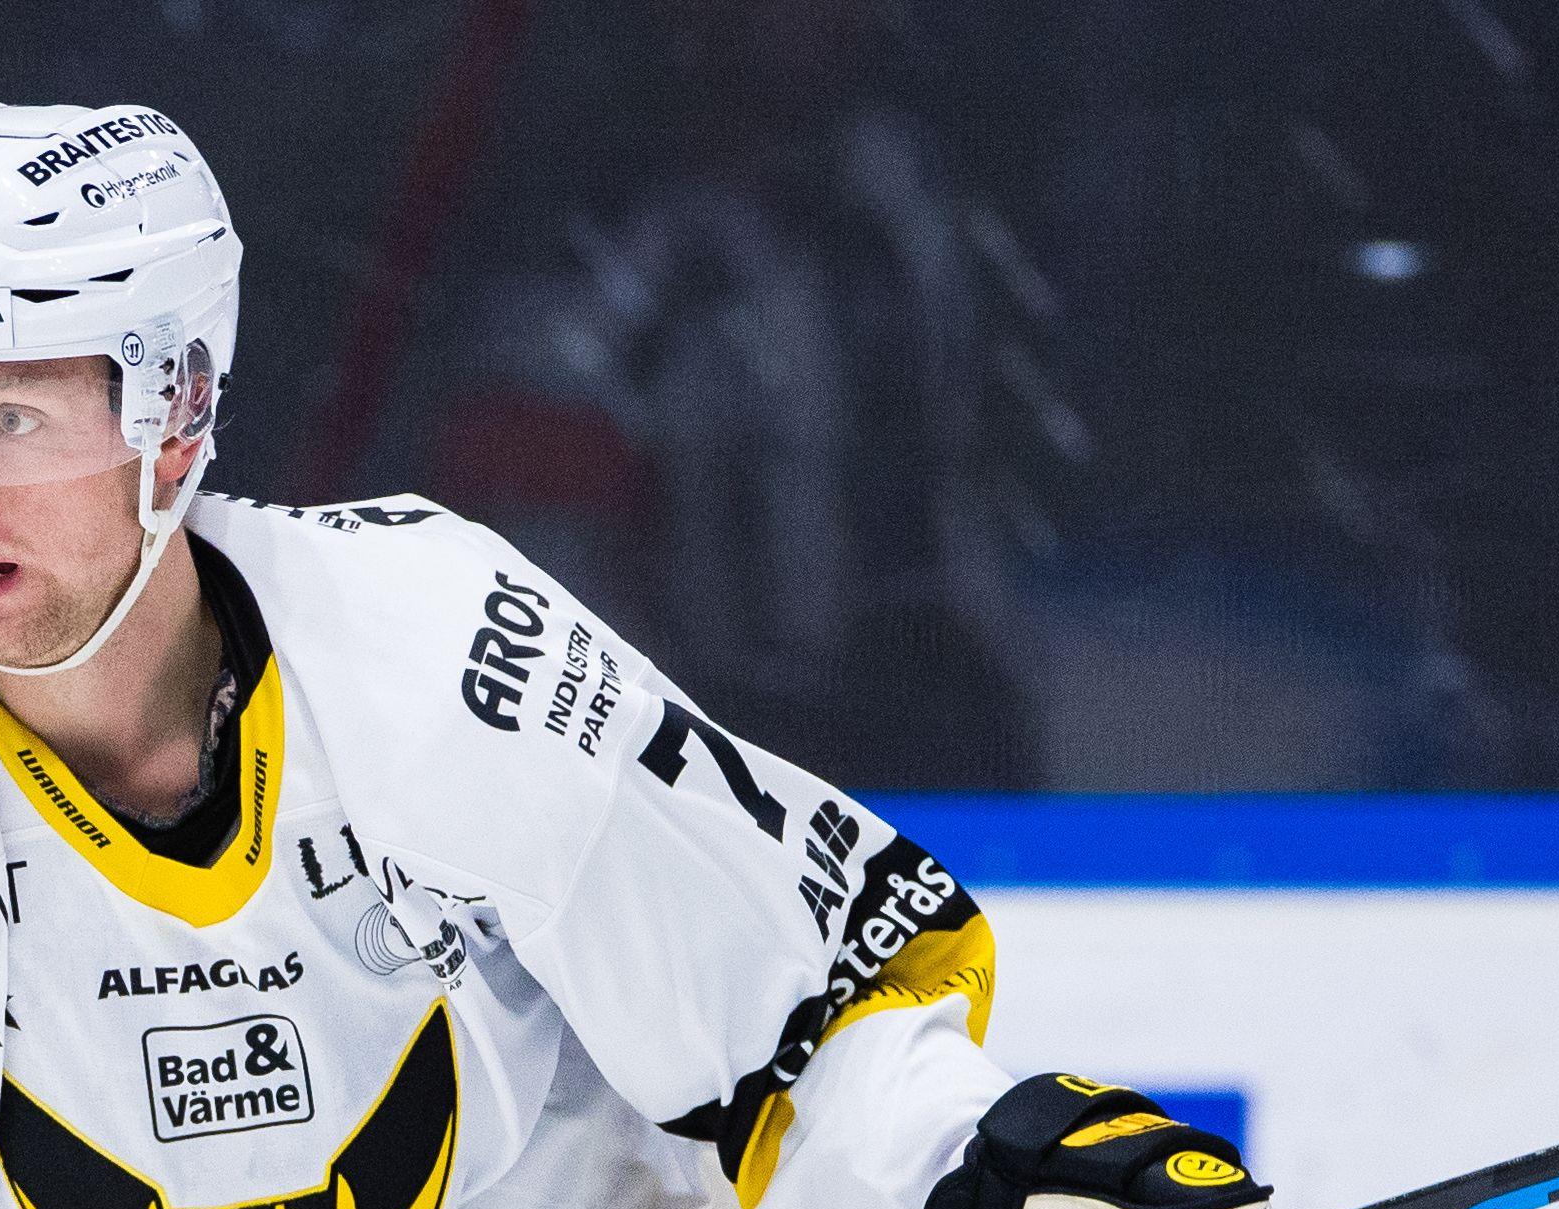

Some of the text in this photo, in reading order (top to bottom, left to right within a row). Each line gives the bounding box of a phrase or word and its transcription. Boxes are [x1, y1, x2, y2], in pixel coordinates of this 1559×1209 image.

[544, 621, 595, 737] INDUSTRI
[17, 748, 112, 850] WARRIOR
[244, 748, 269, 867] WARRIOR
[637, 697, 788, 845] 7
[157, 1022, 296, 1088] Bad &
[161, 1082, 301, 1129] Värme
